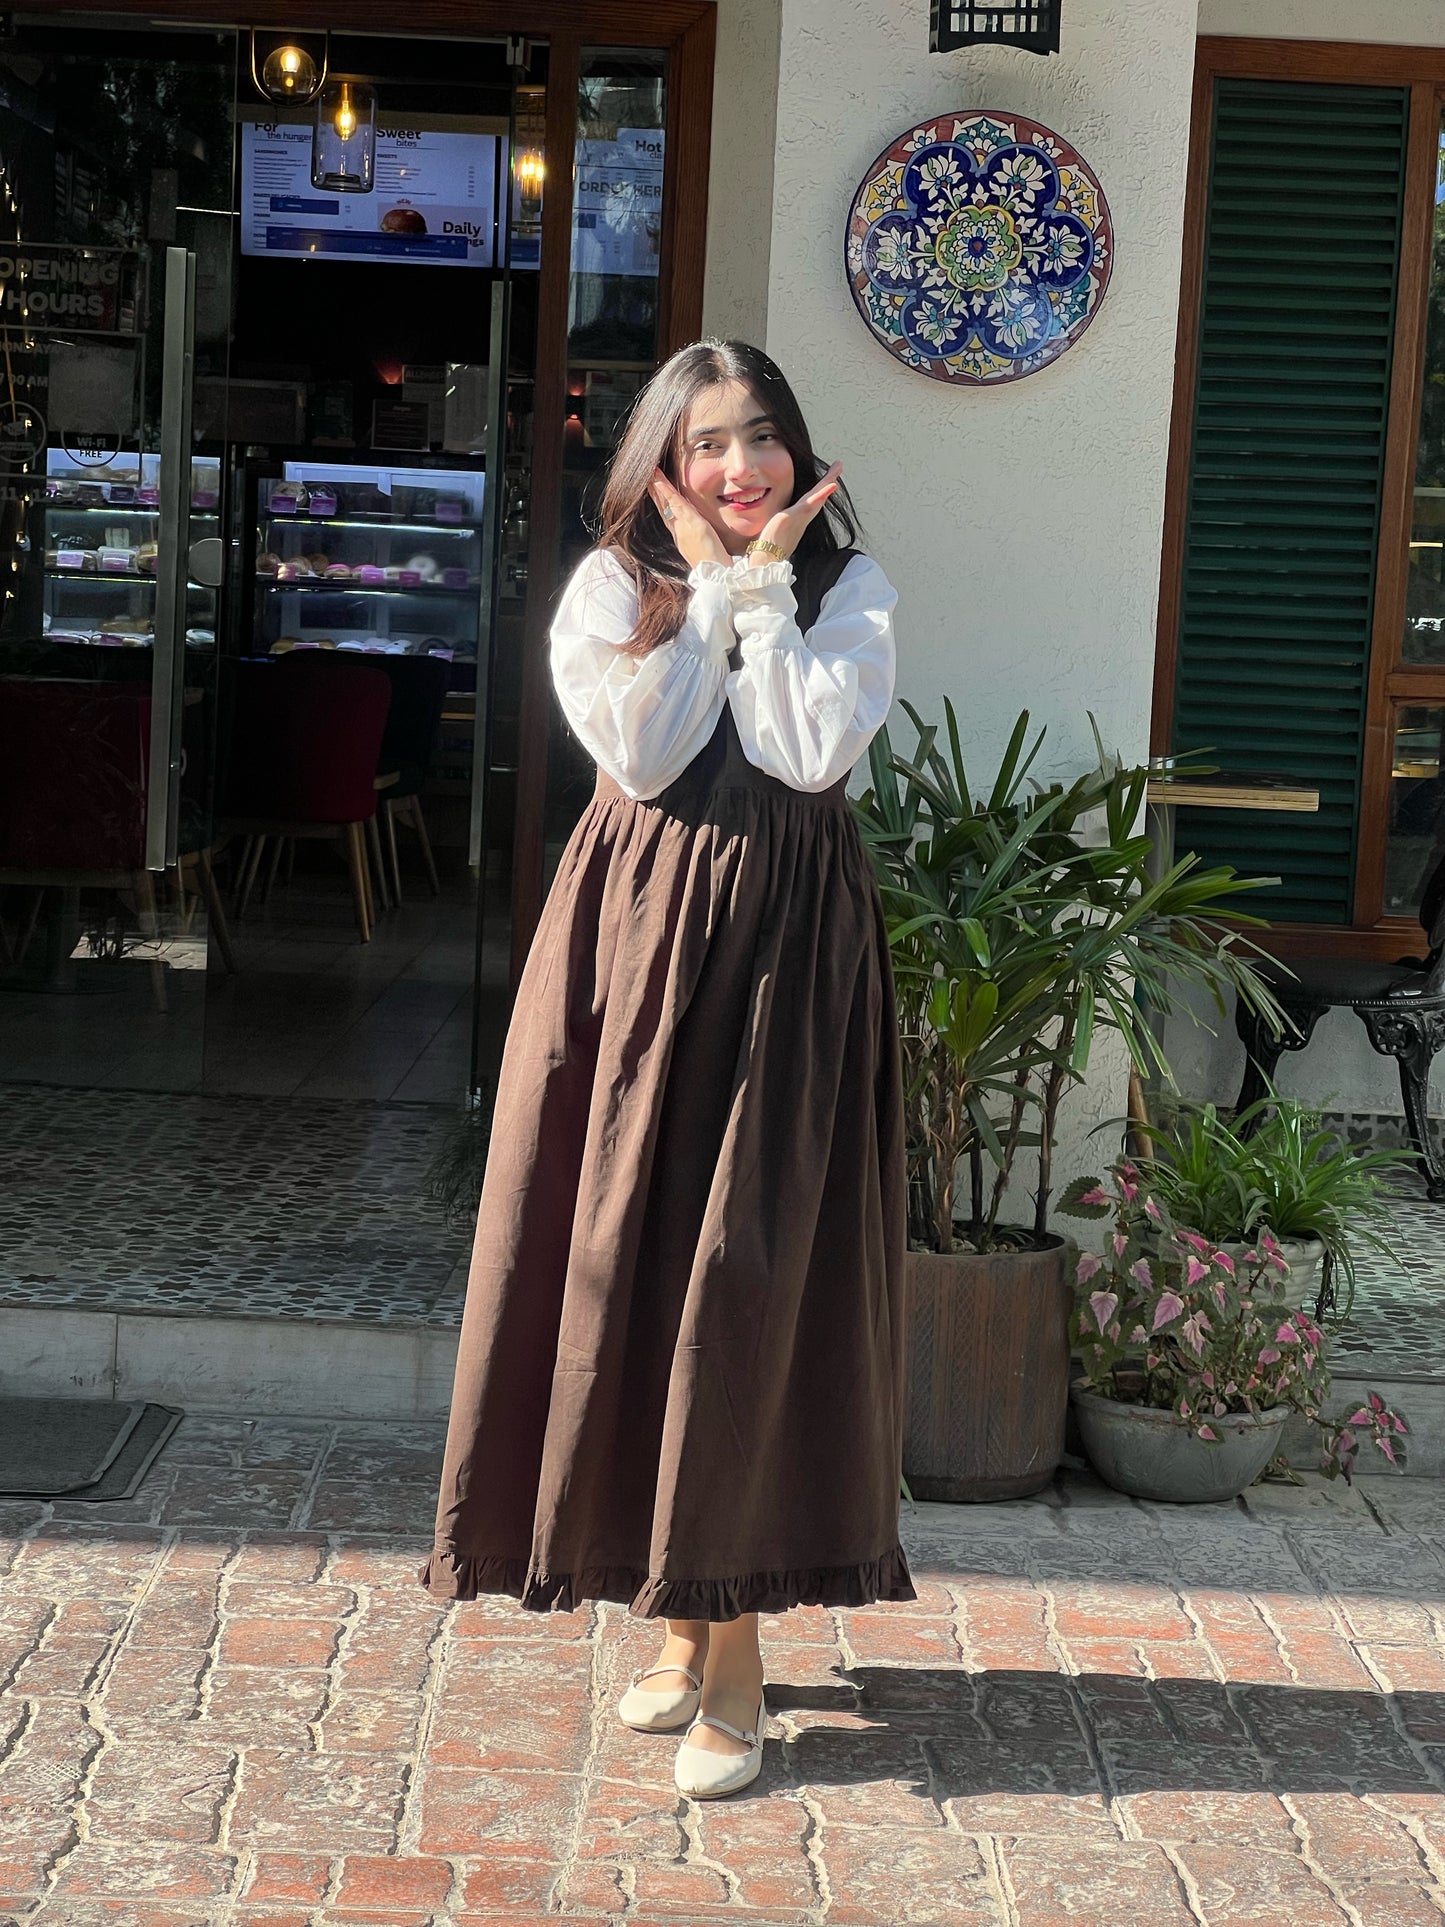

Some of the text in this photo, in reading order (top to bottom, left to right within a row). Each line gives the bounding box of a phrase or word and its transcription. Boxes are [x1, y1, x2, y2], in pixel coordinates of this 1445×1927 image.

[255, 122, 278, 132] For
[267, 131, 281, 140] the
[376, 130, 421, 140] Sweet
[396, 138, 417, 148] bites
[635, 140, 662, 153] Hot
[443, 221, 481, 238] Daily
[0, 256, 119, 286] OPENING
[7, 289, 104, 316] HOURS
[80, 449, 102, 459] FREE
